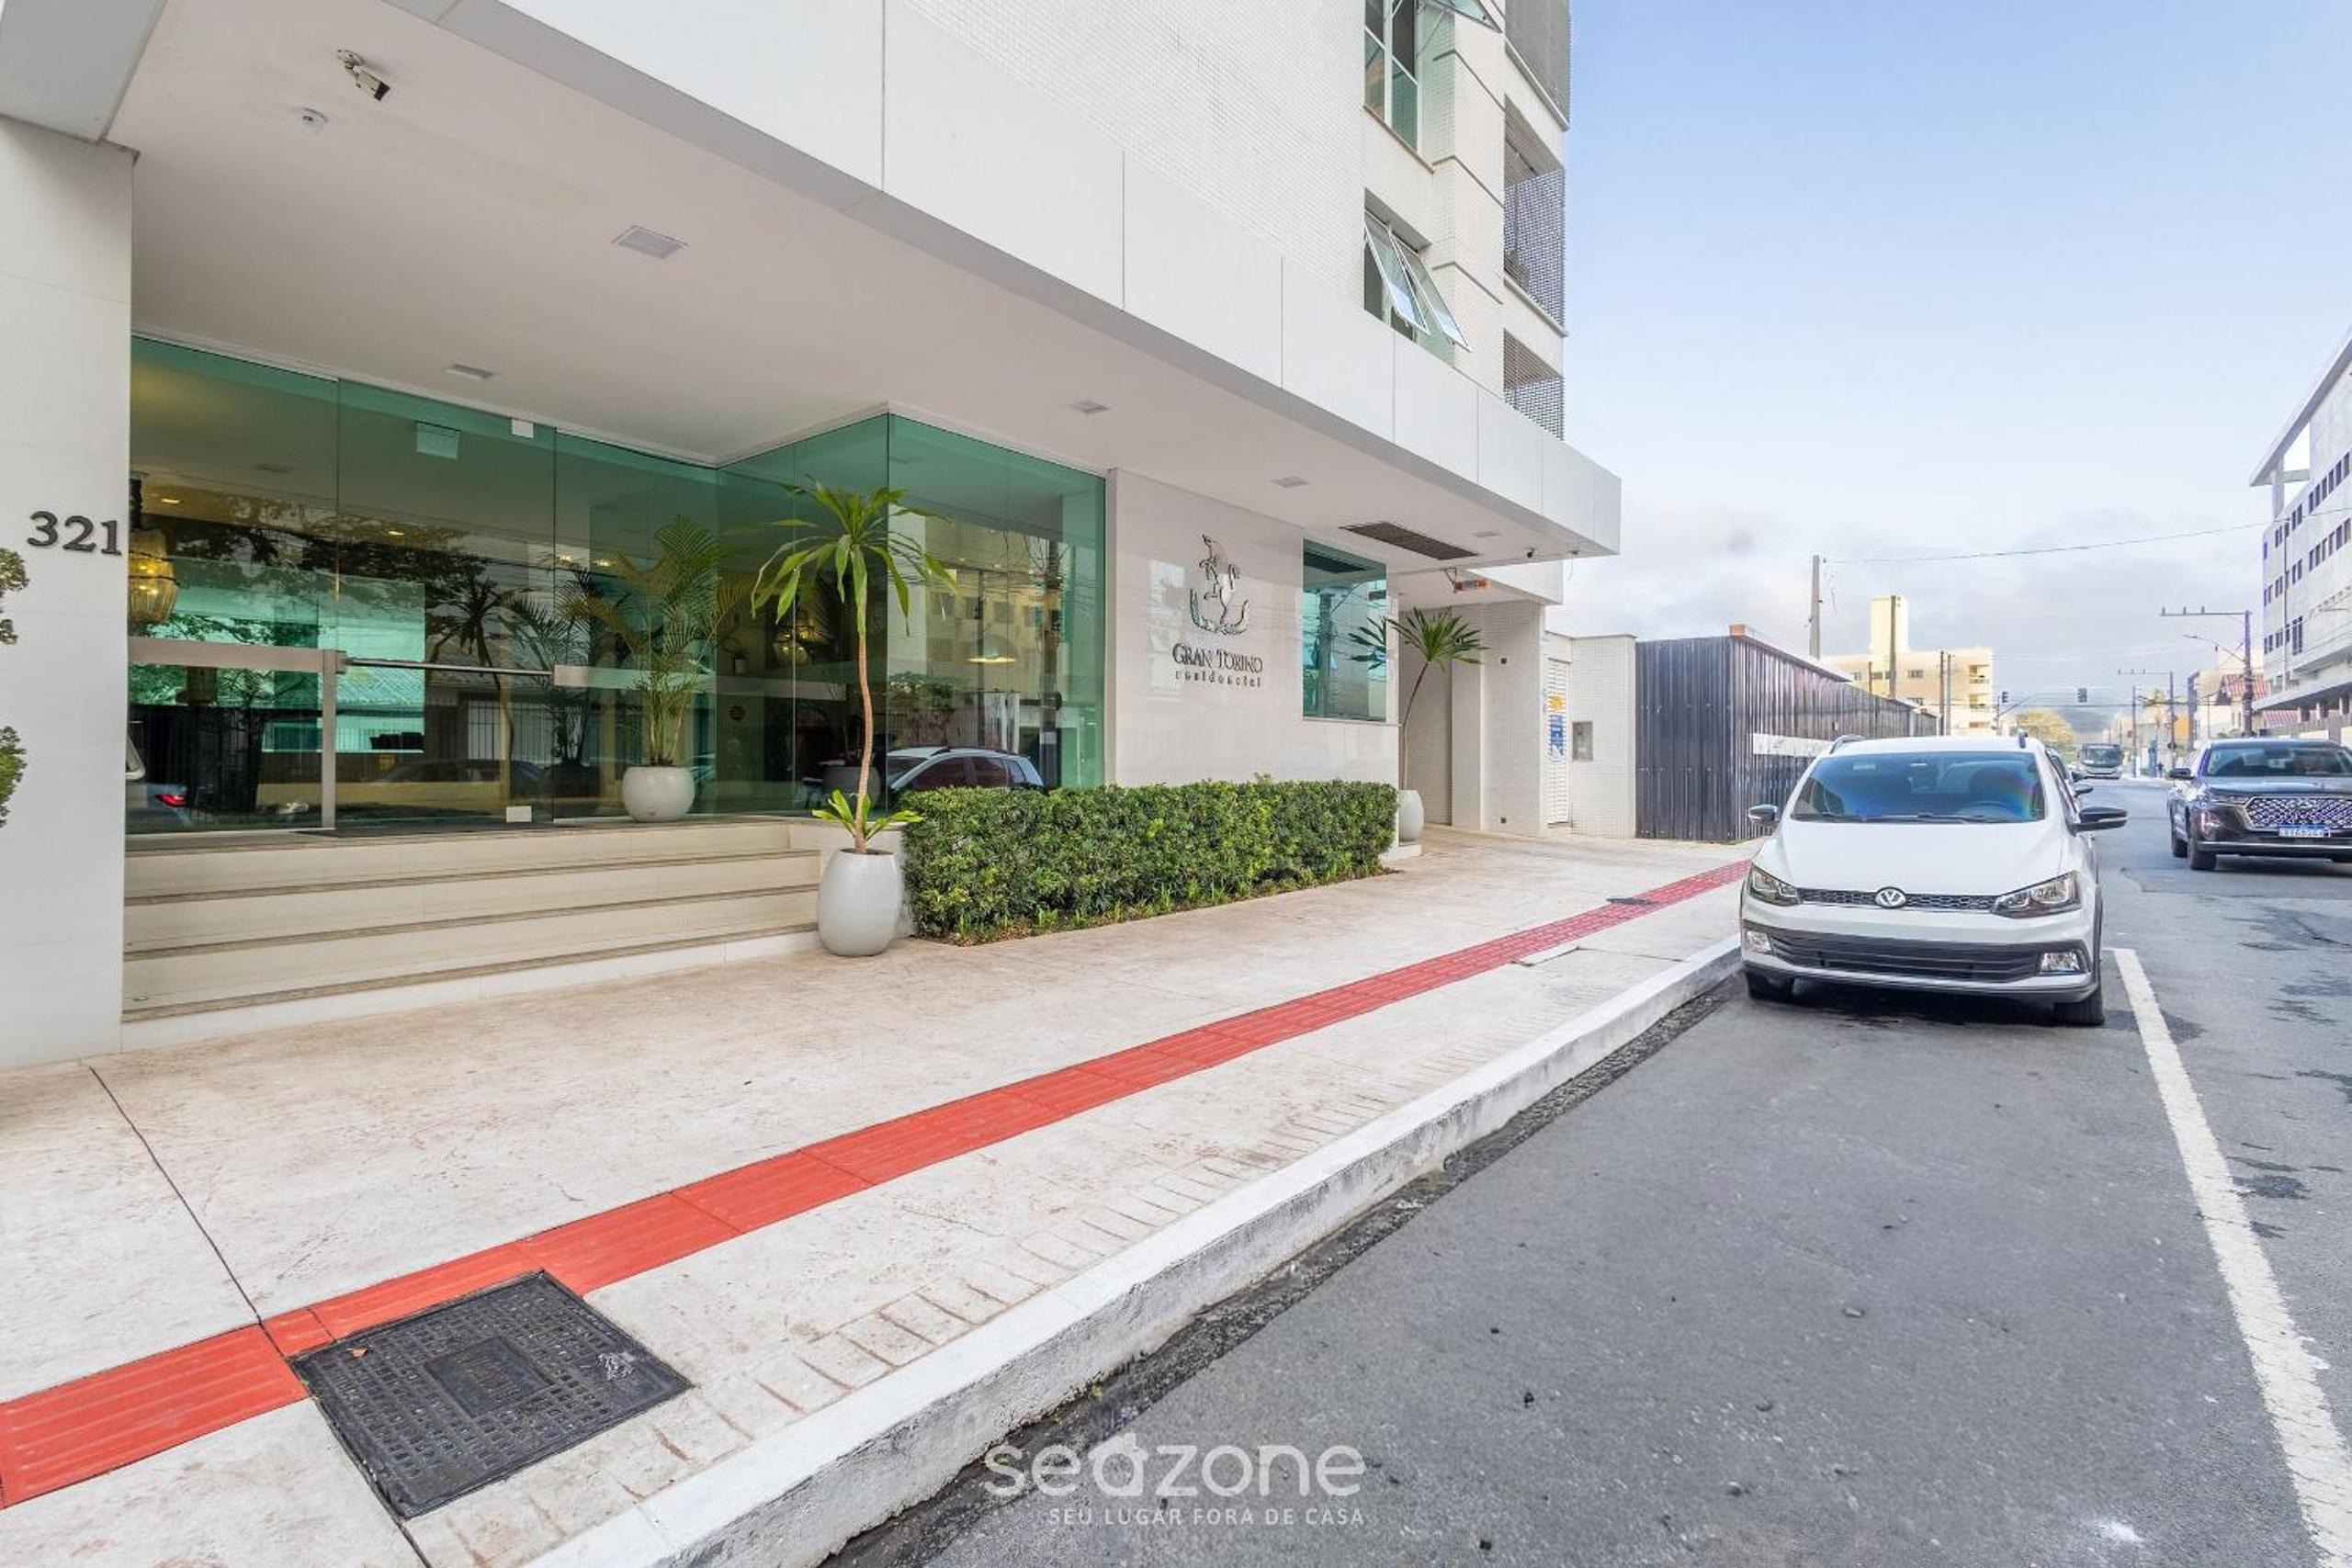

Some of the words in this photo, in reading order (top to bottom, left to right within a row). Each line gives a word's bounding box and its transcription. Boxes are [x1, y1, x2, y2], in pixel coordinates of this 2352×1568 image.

[27, 511, 121, 556] 321
[1172, 643, 1213, 669] GRAN
[1216, 649, 1263, 673] TORINO
